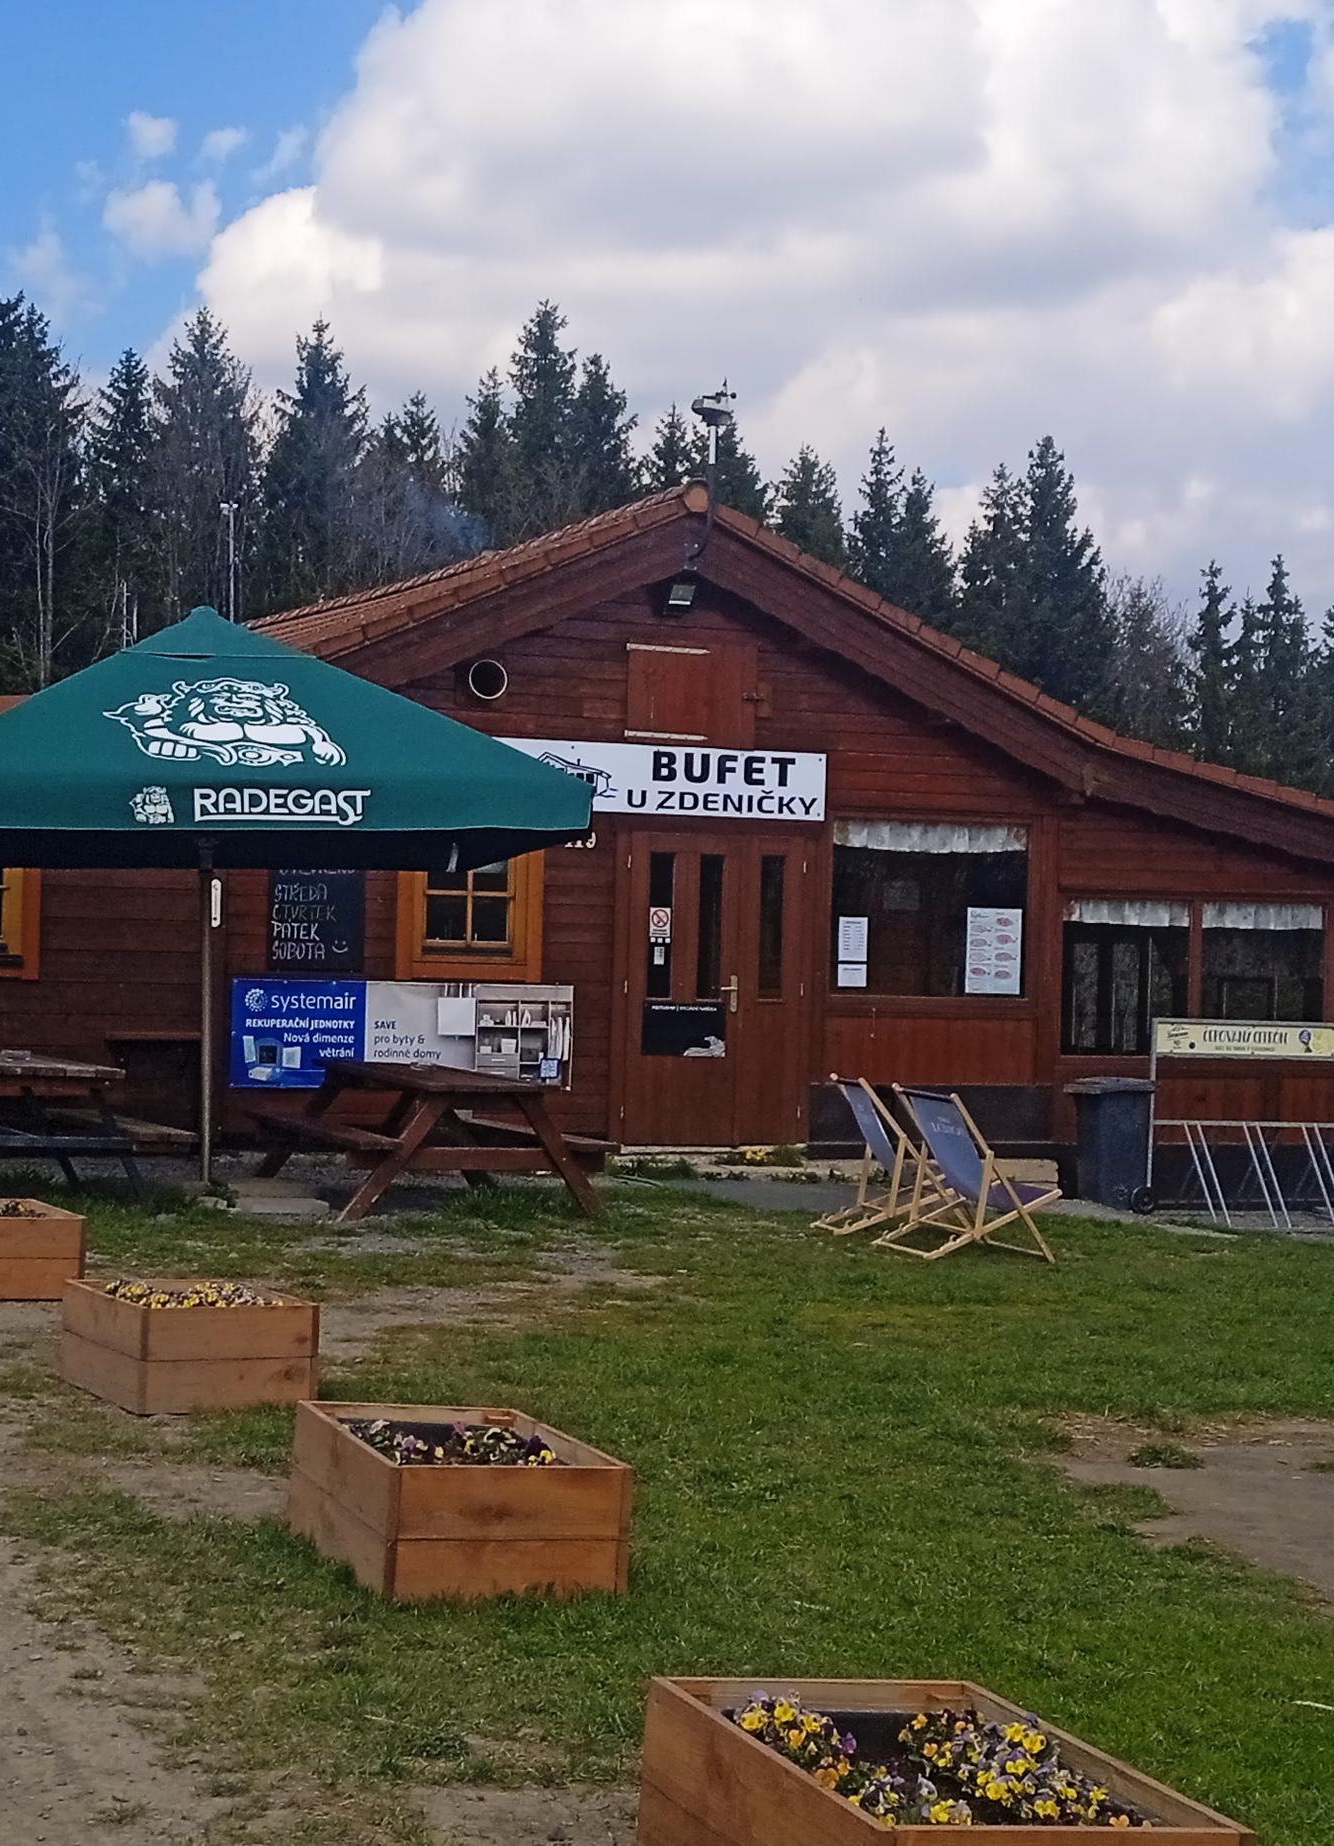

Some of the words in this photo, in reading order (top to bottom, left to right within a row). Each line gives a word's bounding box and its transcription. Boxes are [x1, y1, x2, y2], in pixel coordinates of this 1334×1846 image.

[652, 751, 796, 787] BUFET
[193, 787, 373, 825] RADEGAST
[627, 789, 647, 808] U
[655, 789, 818, 815] ZDENIČKY
[274, 883, 327, 902] STŘEDA
[272, 940, 325, 960] SOBOTA
[271, 992, 357, 1012] systemair
[245, 1017, 309, 1028] REKUPERAČNÍ
[310, 1020, 355, 1030] JEDNOTKY
[374, 1021, 396, 1030] SAVE
[283, 1032, 310, 1043] Nová
[312, 1032, 355, 1043] dimenze
[374, 1037, 389, 1046] pro
[392, 1034, 415, 1046] byty
[319, 1048, 354, 1058] větrání
[374, 1048, 410, 1058] rodinné
[413, 1048, 441, 1060] domy
